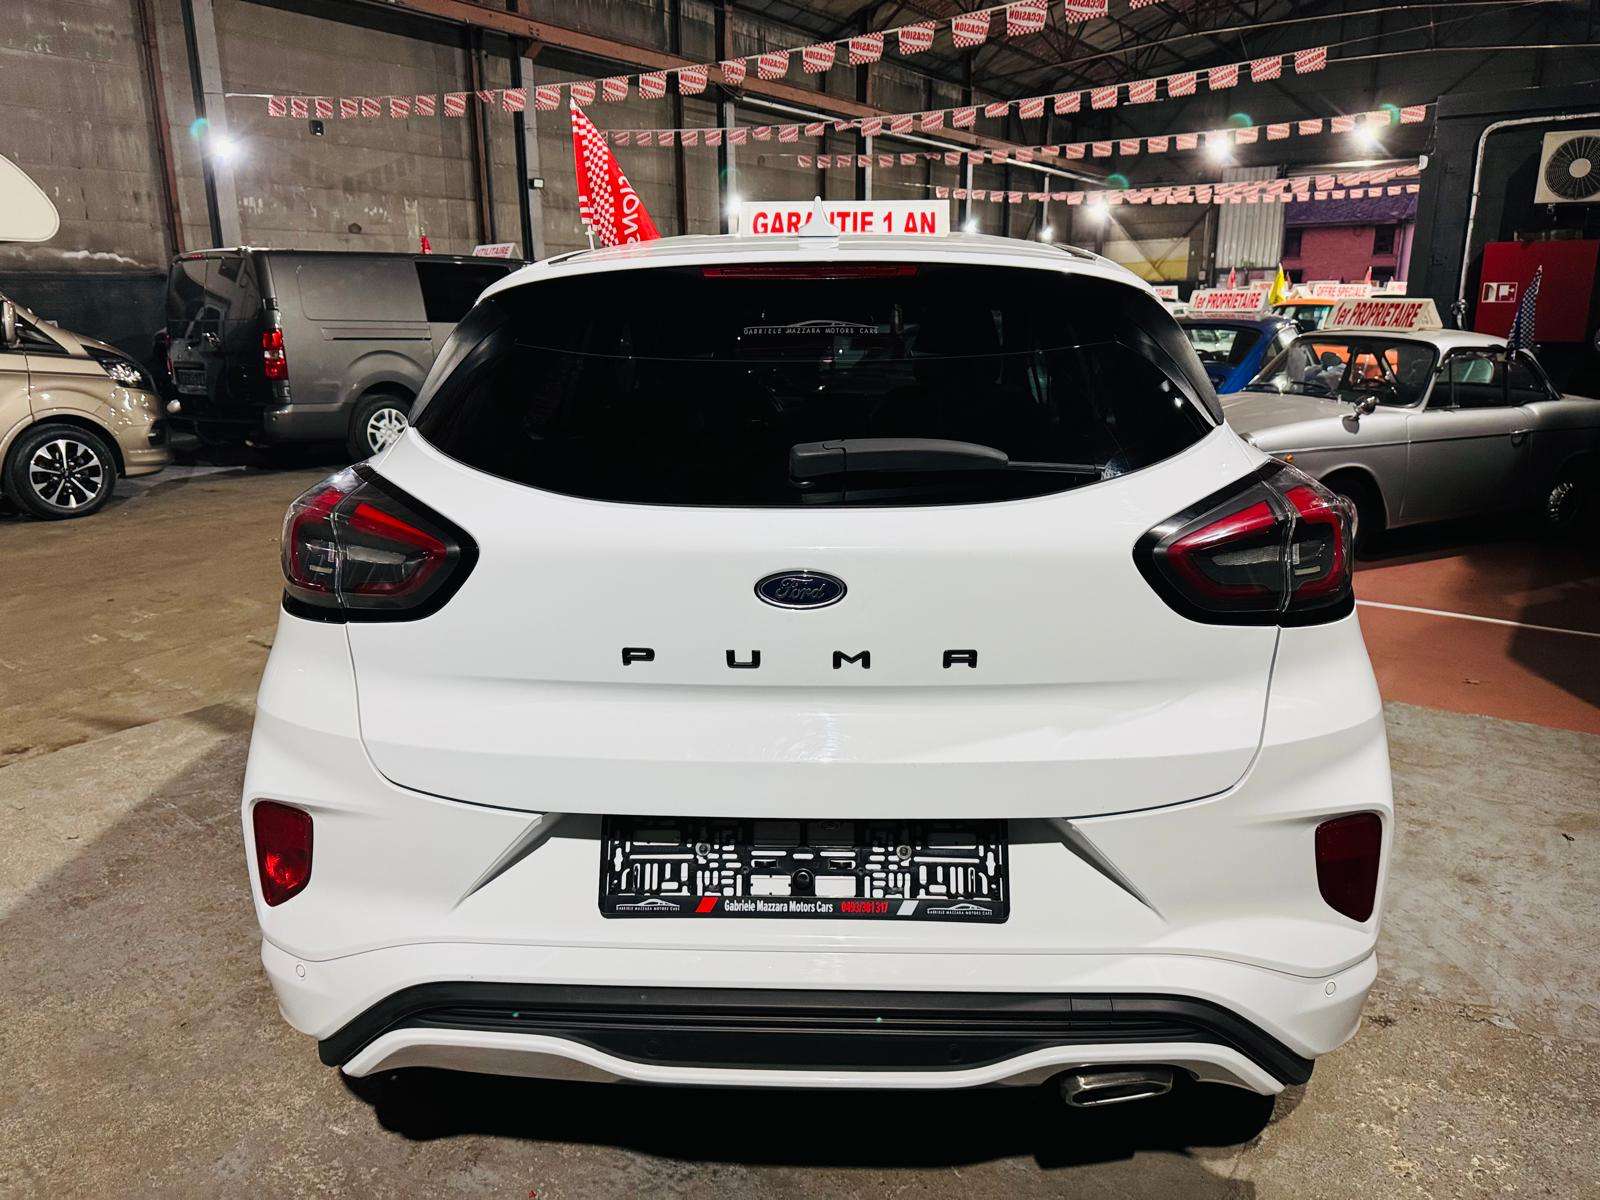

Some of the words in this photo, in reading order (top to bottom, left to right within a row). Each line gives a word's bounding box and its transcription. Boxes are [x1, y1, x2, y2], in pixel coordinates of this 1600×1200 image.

[1252, 59, 1281, 77] OCCASION
[1296, 52, 1326, 69] OCCASION
[882, 212, 892, 232] 1
[904, 212, 936, 234] AN
[1193, 294, 1207, 308] 1er
[1206, 292, 1261, 308] PROPRIETAIRE
[1333, 302, 1352, 325] 1er
[1348, 302, 1422, 328] PROPRIETAIRE
[775, 578, 826, 600] Ford
[724, 900, 756, 911] Gabriele
[757, 900, 787, 912] Mazzara
[789, 901, 815, 912] Motors
[817, 901, 833, 912] Cars
